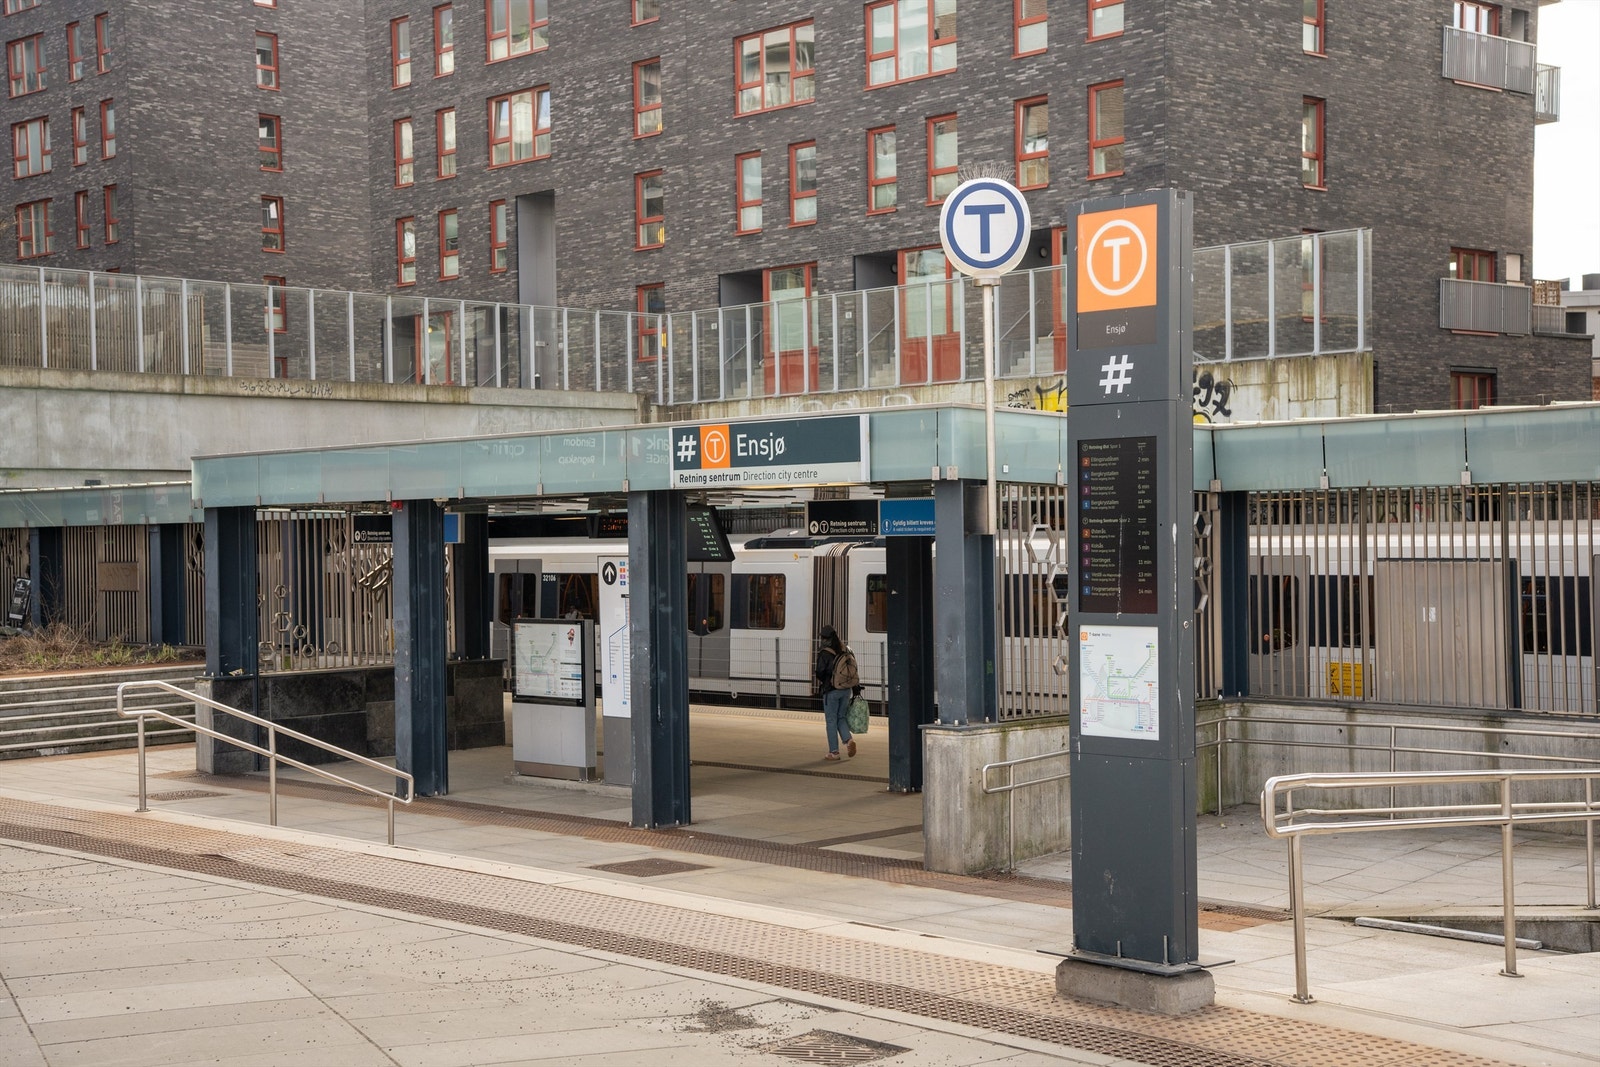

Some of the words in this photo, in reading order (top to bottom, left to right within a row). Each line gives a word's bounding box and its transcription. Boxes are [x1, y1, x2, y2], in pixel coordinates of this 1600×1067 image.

[964, 204, 1005, 254] T
[1103, 237, 1130, 282] T
[1106, 324, 1125, 334] Ensjø
[710, 438, 721, 459] T
[737, 432, 784, 461] Ensjø
[679, 473, 707, 484] Retning
[709, 472, 740, 482] sentrum
[743, 470, 776, 481] Direction
[778, 470, 792, 481] city
[794, 469, 818, 479] centre
